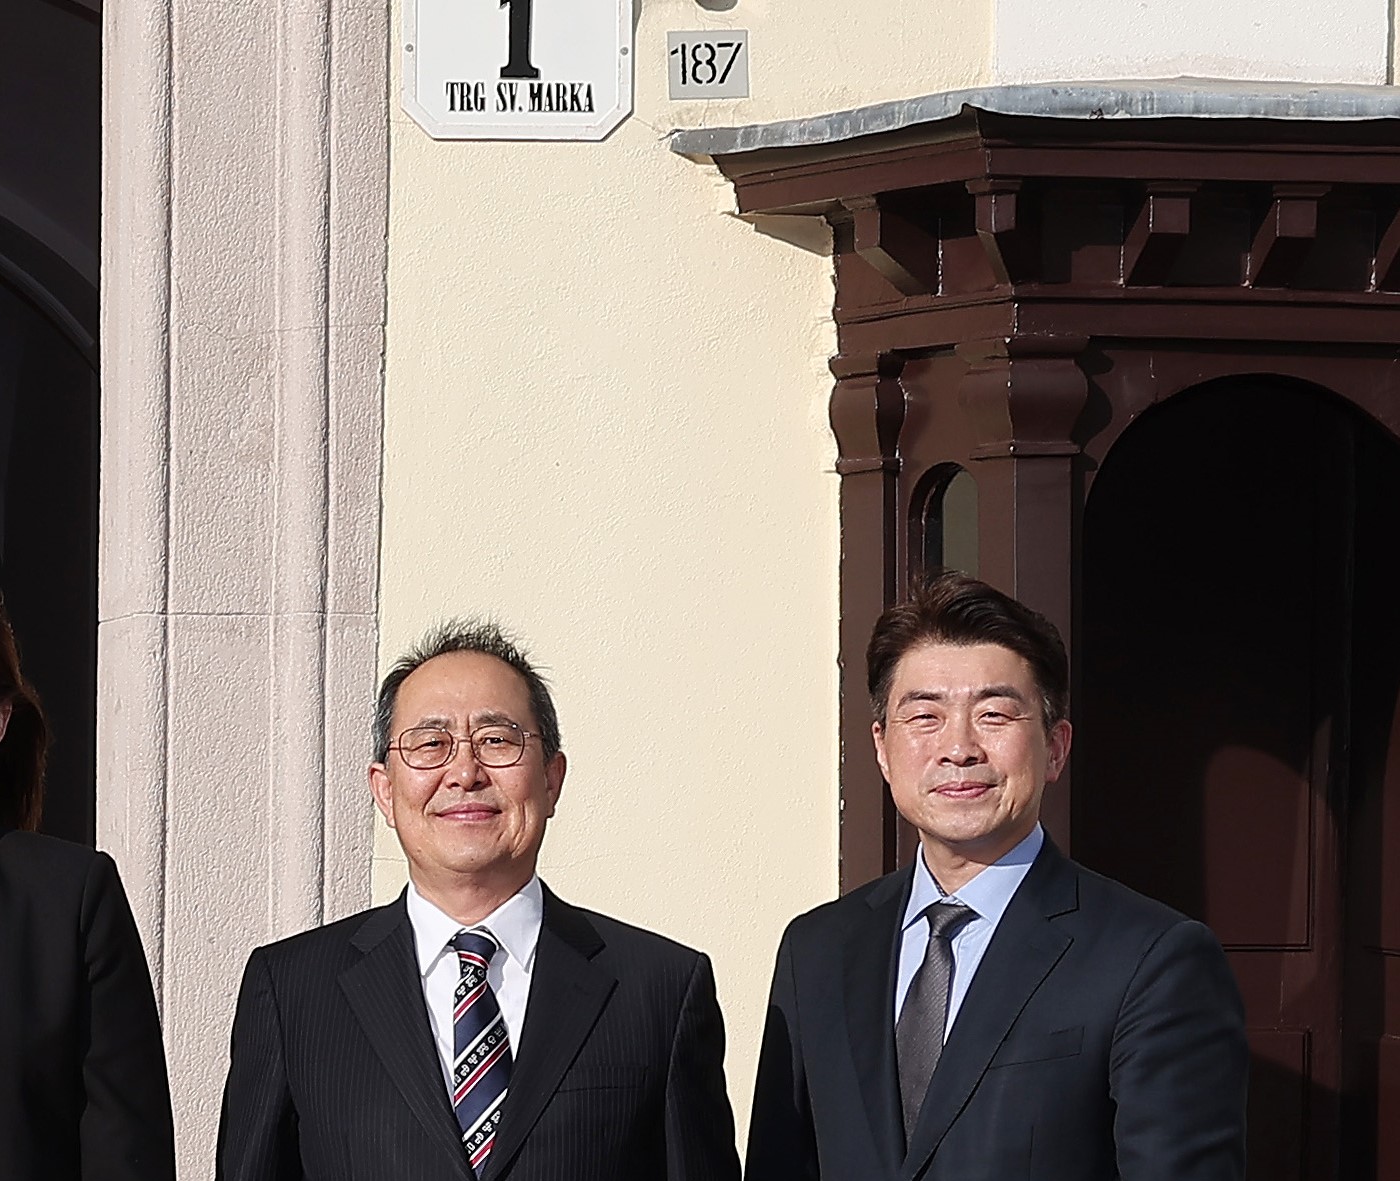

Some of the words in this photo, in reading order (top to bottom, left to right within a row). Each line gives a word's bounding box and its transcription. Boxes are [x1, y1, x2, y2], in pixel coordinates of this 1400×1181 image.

[498, 0, 541, 79] 1
[670, 42, 743, 85] 187
[445, 81, 487, 112] TRG
[496, 81, 524, 112] SV.
[528, 82, 595, 113] MARKA
